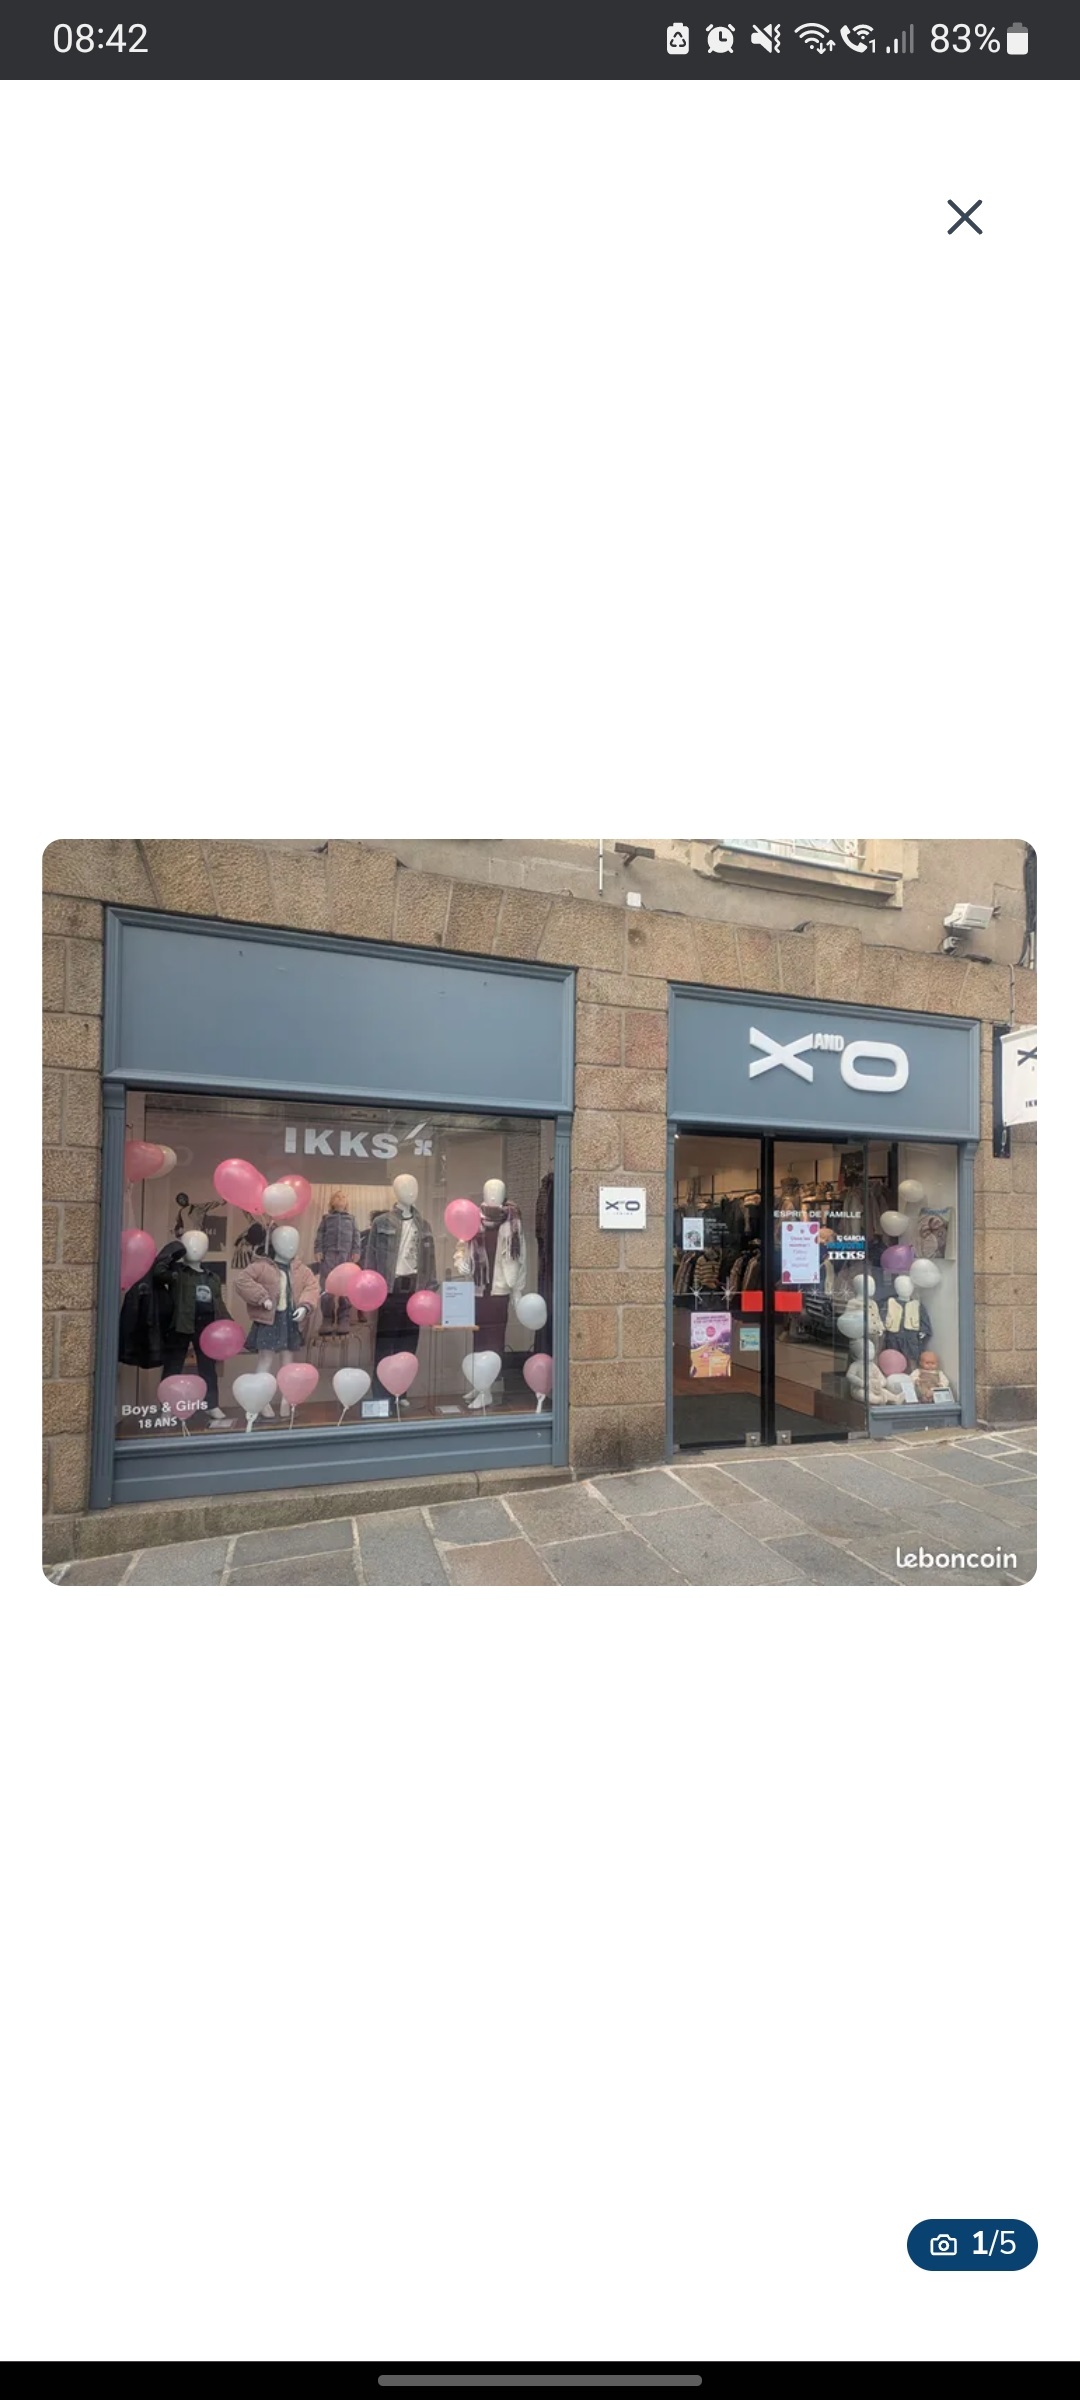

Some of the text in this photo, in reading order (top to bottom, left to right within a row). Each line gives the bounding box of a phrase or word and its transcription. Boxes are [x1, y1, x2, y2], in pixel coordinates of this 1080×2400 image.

[53, 23, 149, 54] 08:42
[930, 23, 1001, 54] 83%
[284, 1127, 399, 1160] IKKS
[809, 1210, 821, 1219] DE
[823, 1210, 862, 1219] FAMILLE
[827, 1250, 866, 1260] IKKS
[121, 1399, 209, 1417] Boys & Girls
[138, 1416, 178, 1429] 18 ANS
[972, 2229, 1018, 2257] 1/5
